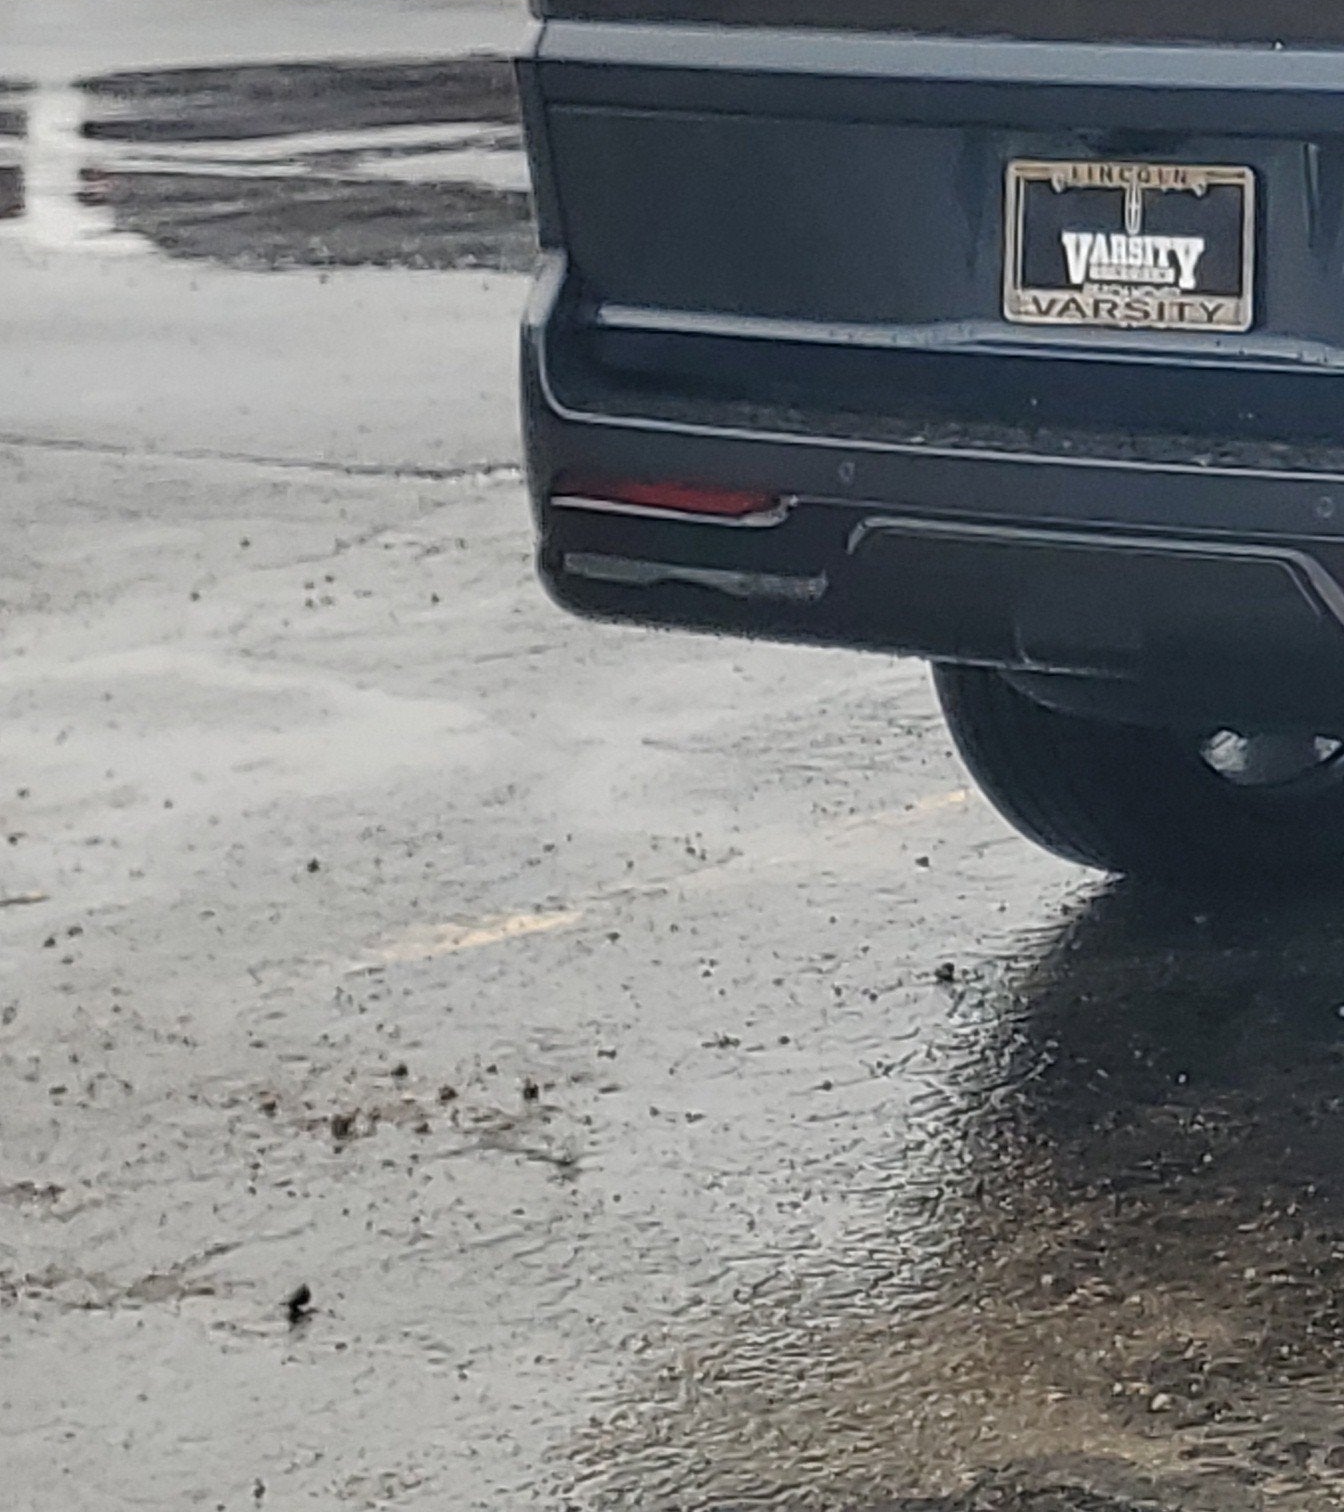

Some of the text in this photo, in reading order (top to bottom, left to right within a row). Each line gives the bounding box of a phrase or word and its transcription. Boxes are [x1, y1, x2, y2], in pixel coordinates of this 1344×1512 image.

[1071, 165, 1188, 186] LINCOLN
[1061, 231, 1205, 290] VARSITY
[1031, 295, 1224, 324] VARSITY
